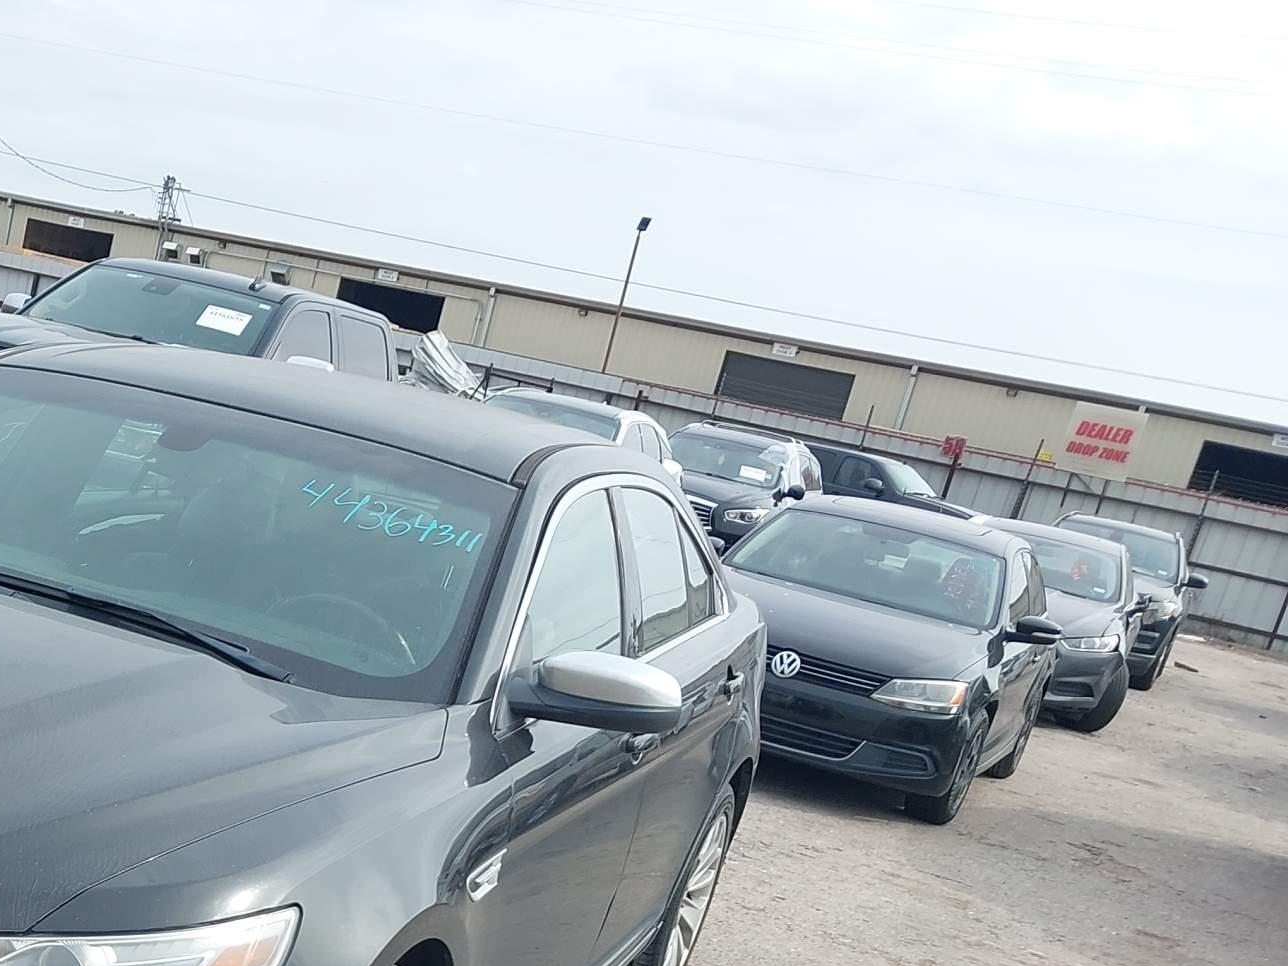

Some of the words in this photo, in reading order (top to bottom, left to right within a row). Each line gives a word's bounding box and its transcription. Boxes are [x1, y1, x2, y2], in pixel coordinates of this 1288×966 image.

[1075, 420, 1134, 445] DEALER
[1065, 440, 1098, 457] DROP
[1098, 446, 1131, 463] ZONE
[302, 479, 483, 553] 44364311
